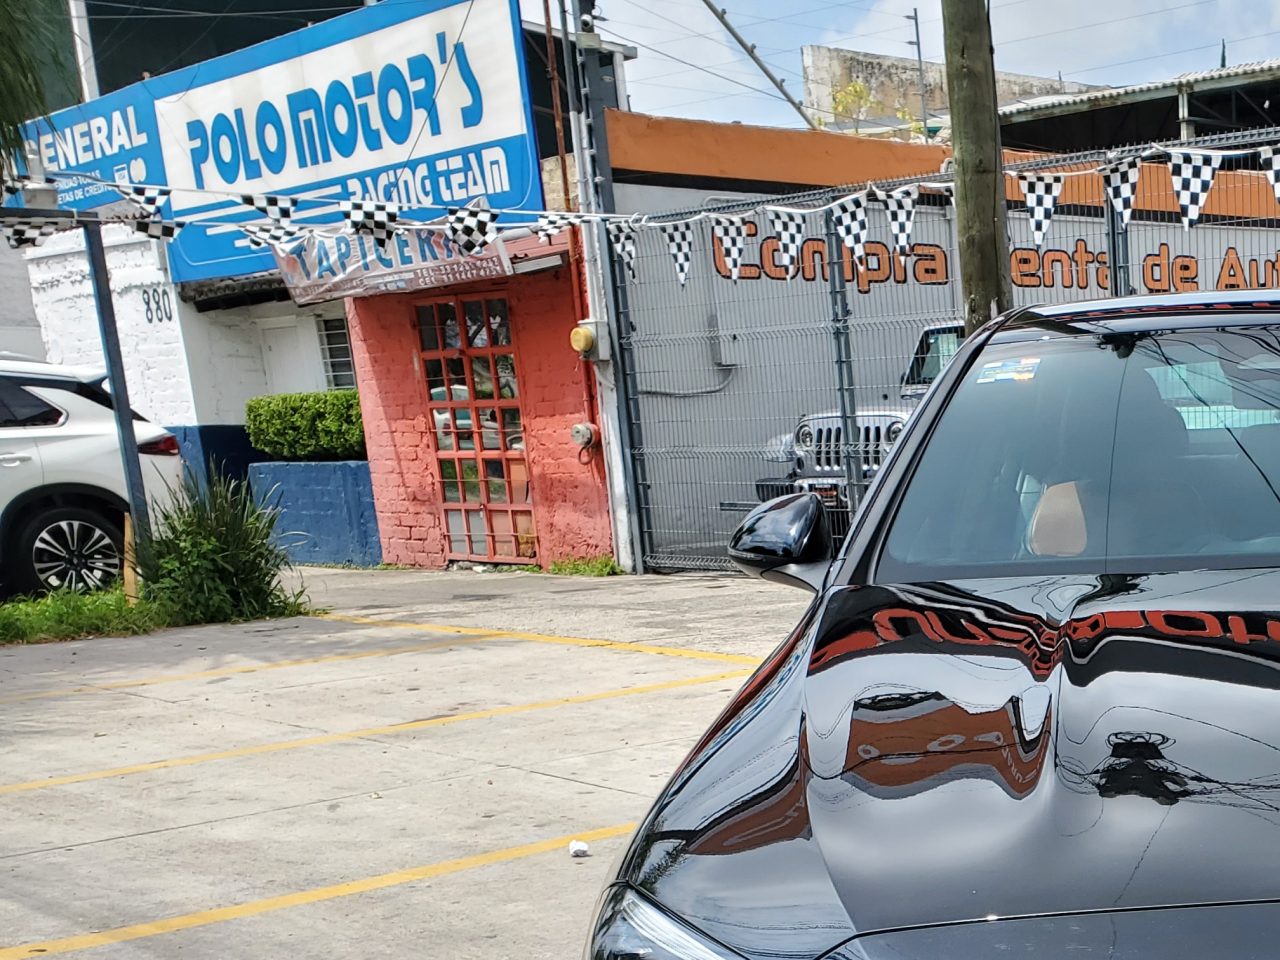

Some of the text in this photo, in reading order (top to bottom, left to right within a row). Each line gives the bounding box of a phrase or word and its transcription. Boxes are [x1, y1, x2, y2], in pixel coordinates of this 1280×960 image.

[187, 31, 484, 190] POLO MOTOR'S
[346, 146, 511, 211] RACING TEAM
[711, 220, 950, 294] Compra
[1143, 243, 1200, 293] de
[142, 287, 173, 324] 880
